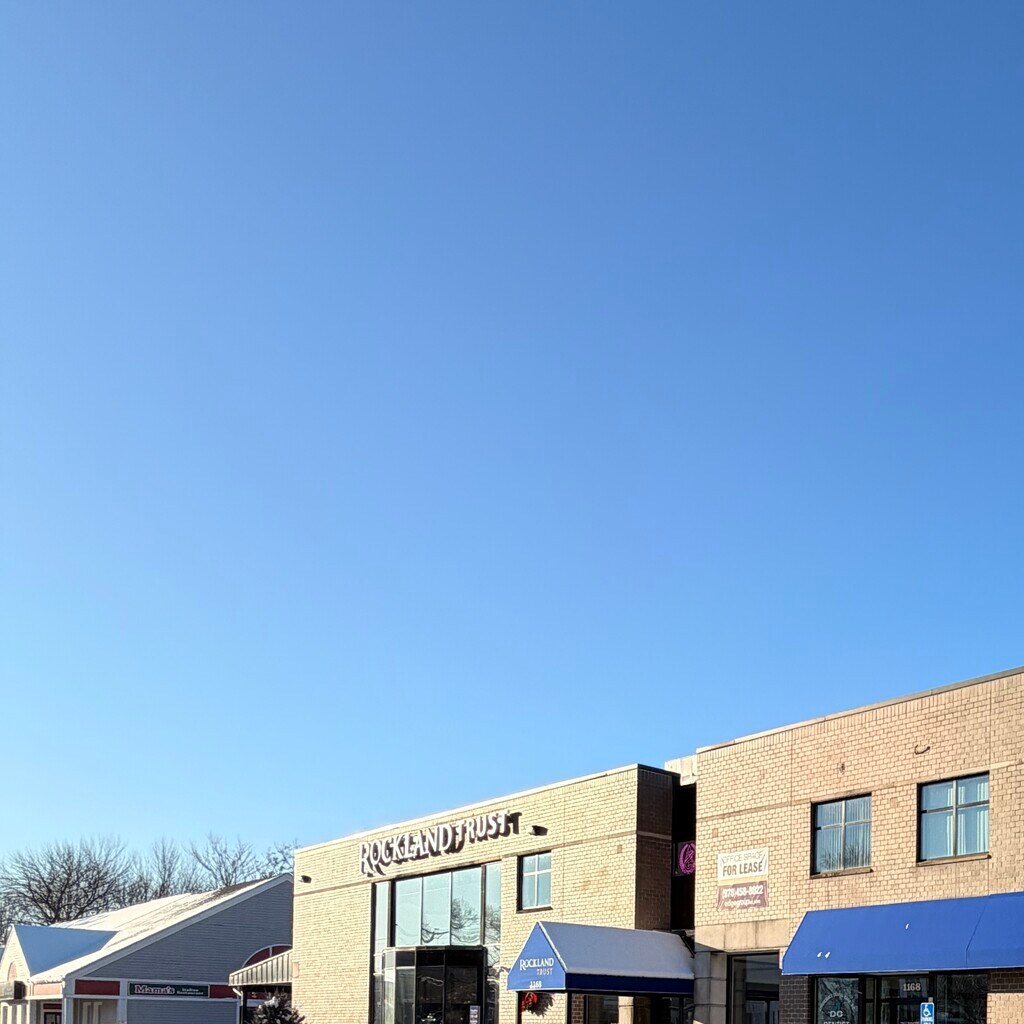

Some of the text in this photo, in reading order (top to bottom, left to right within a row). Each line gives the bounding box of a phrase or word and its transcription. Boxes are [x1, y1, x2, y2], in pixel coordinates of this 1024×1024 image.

[359, 810, 512, 875] ROCKLAND TRUST
[722, 861, 763, 877] FOR LEASE
[519, 957, 555, 976] ROCKLAND TRUST
[134, 984, 175, 995] Mama's
[529, 980, 542, 989] 1168
[902, 982, 921, 991] 1168
